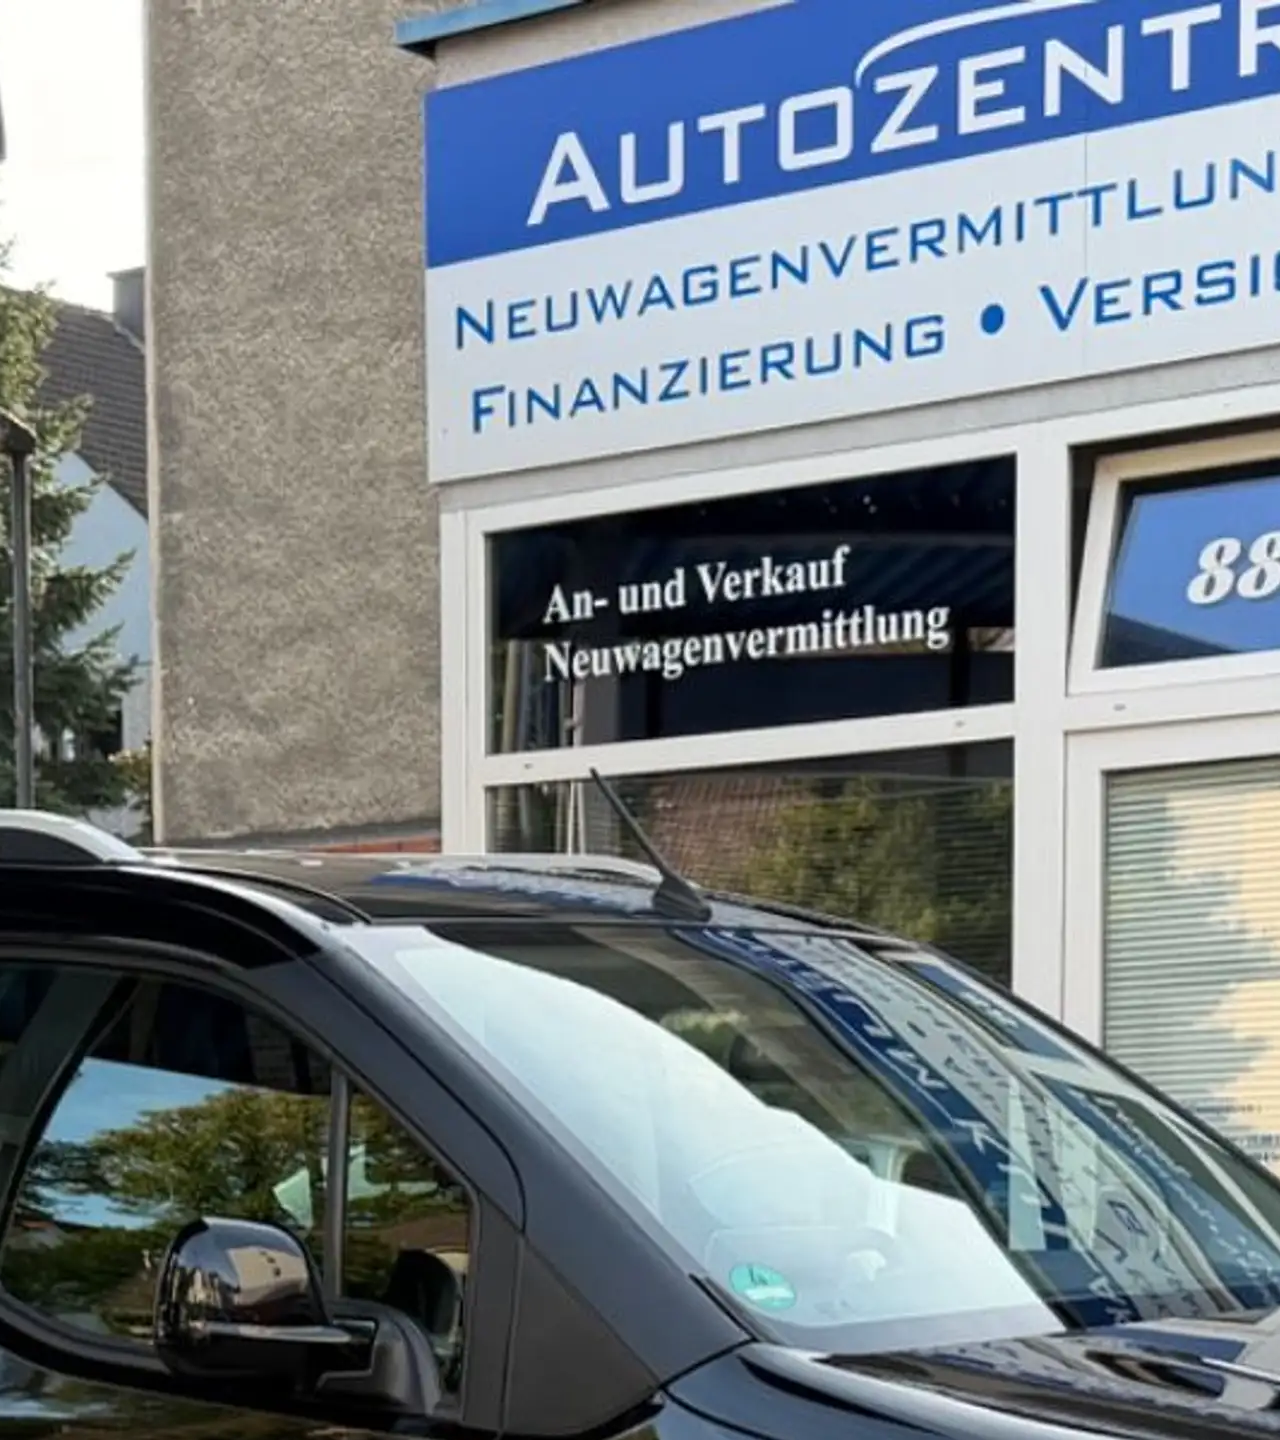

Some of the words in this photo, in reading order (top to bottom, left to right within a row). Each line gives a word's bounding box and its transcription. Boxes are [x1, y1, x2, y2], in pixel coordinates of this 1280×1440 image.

[471, 313, 946, 433] FINANZIERUNG
[542, 583, 609, 625] An-
[618, 568, 687, 615] und
[696, 544, 852, 604] Verkauf
[542, 604, 951, 683] Neuwagenvermittlung
